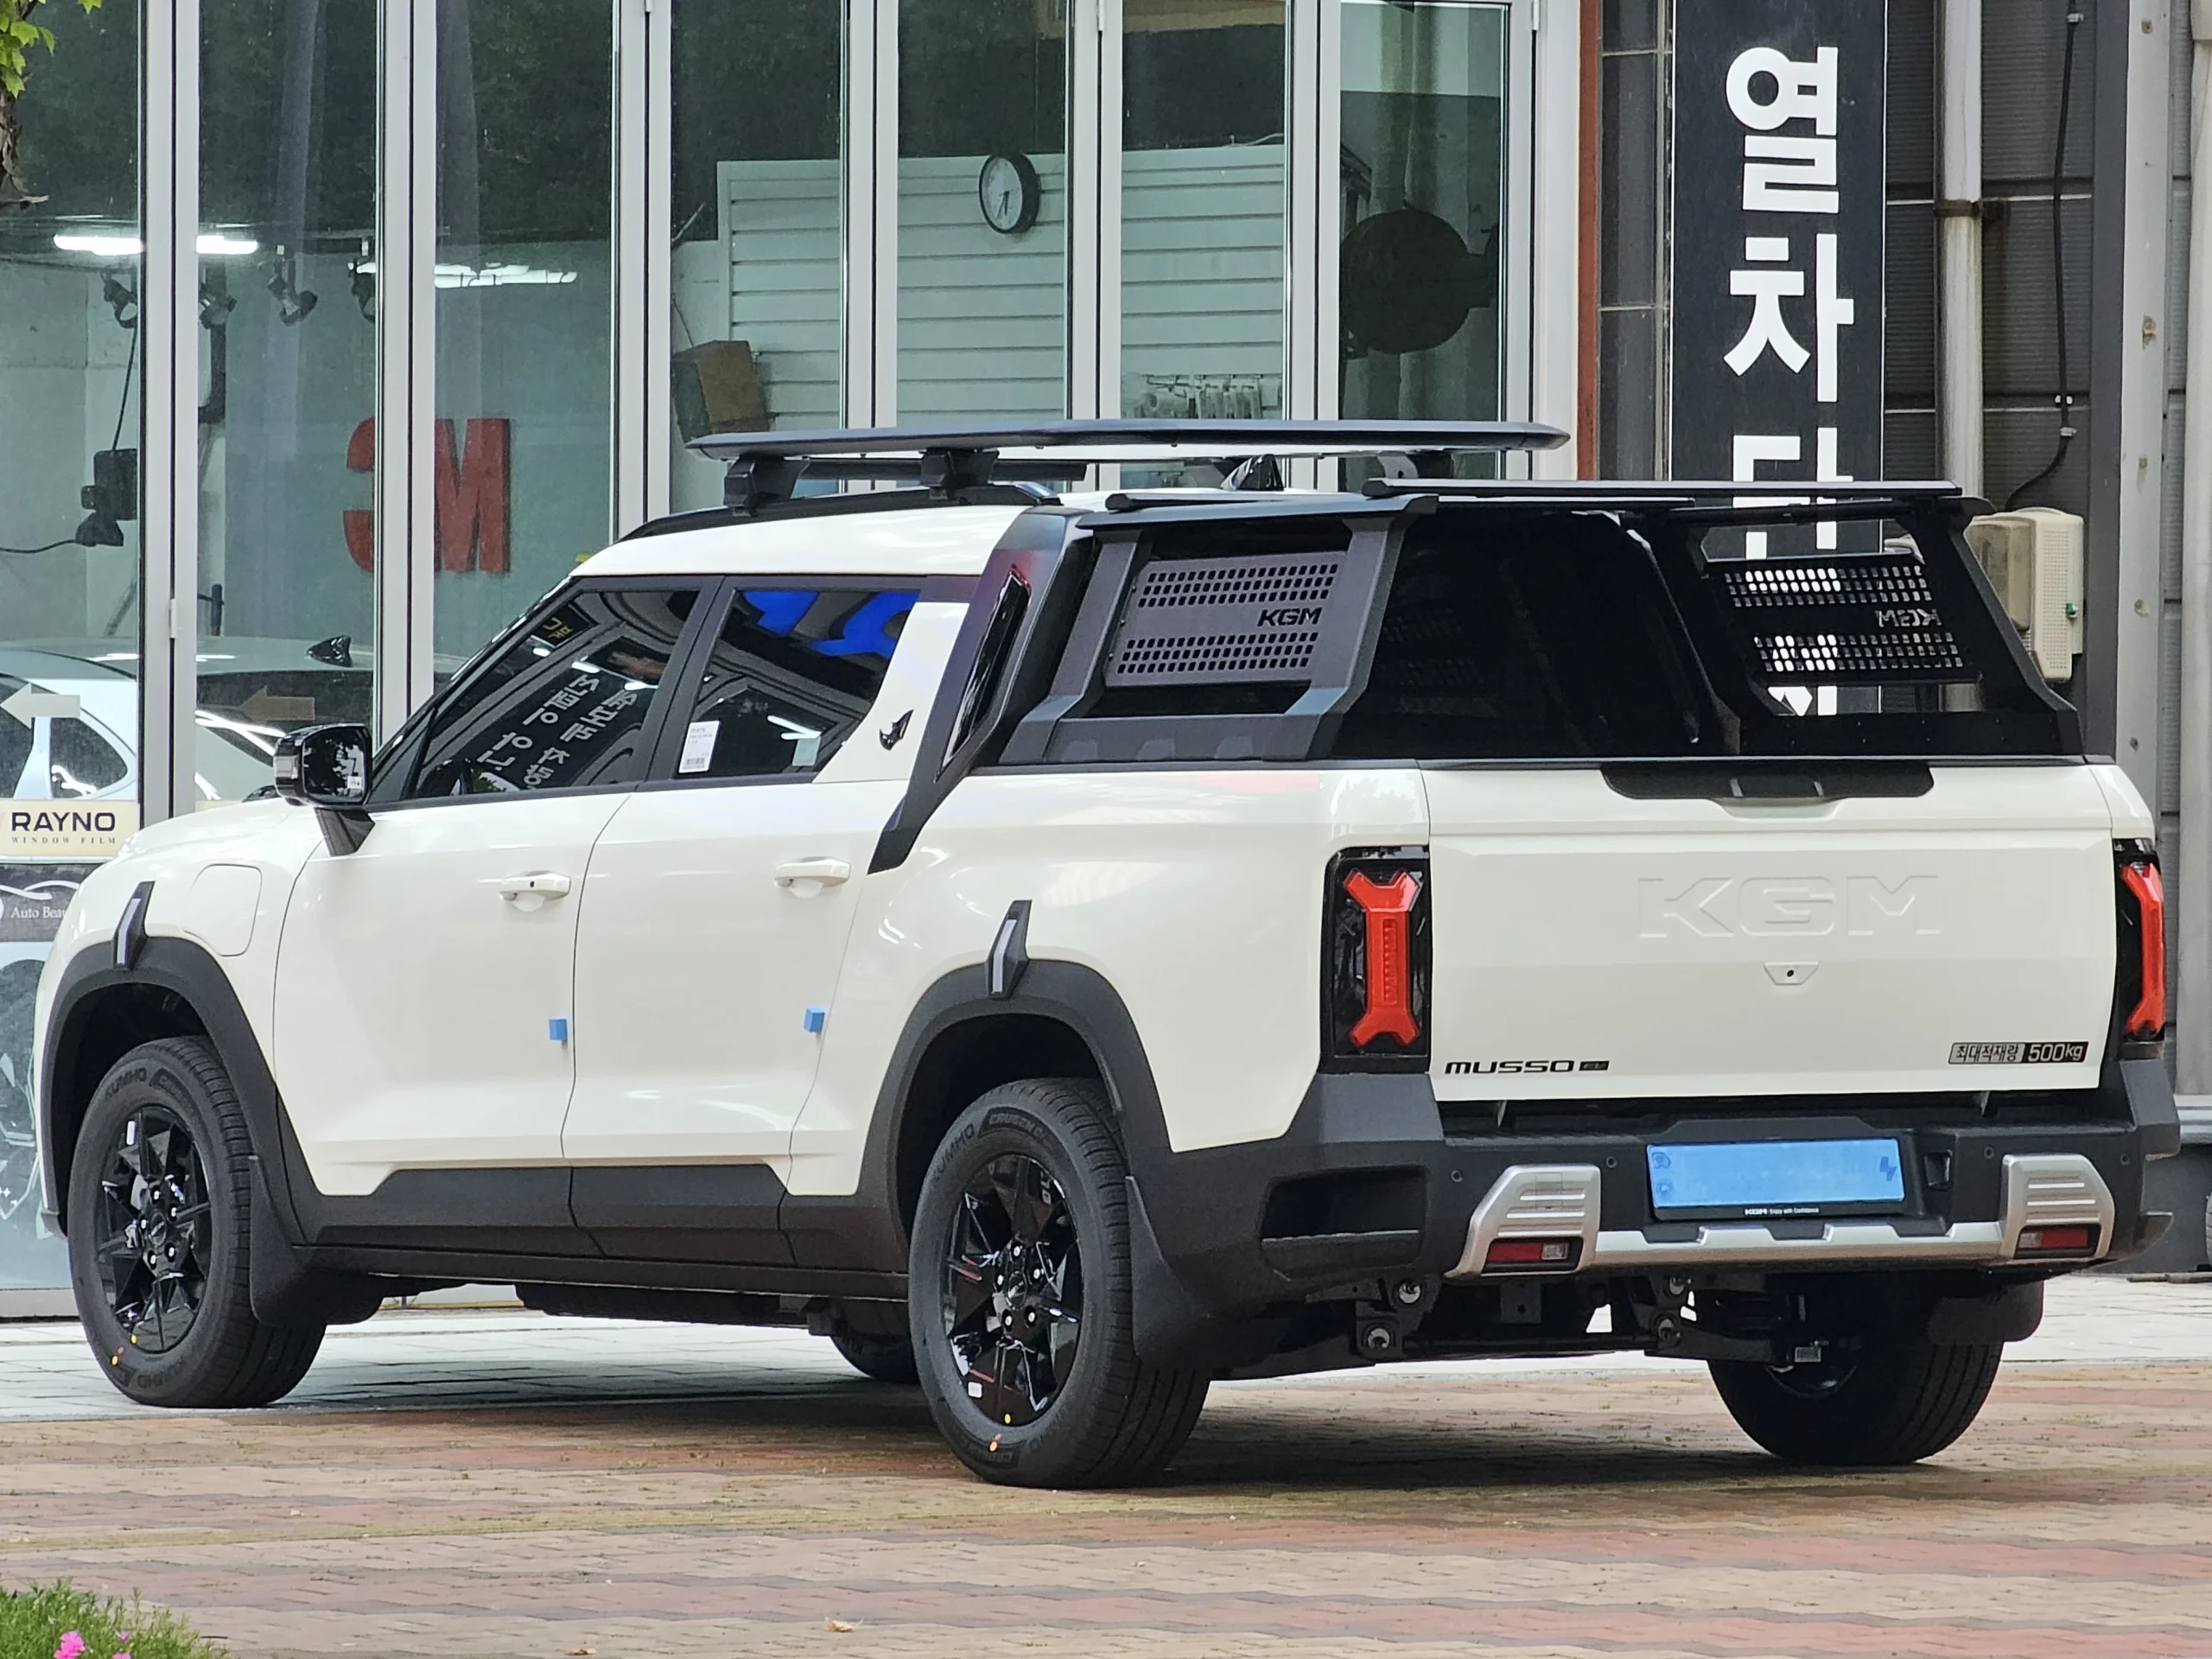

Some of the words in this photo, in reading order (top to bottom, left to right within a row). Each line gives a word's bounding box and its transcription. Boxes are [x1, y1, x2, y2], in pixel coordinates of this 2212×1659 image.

[1257, 607, 1322, 626] KGM
[11, 811, 116, 832] RAYNO
[11, 906, 40, 918] Auto
[1638, 875, 1942, 938] KGM
[1955, 1044, 2018, 1063] 최대적재량
[2028, 1043, 2084, 1063] 500kg
[1445, 1059, 1575, 1074] MUSSO
